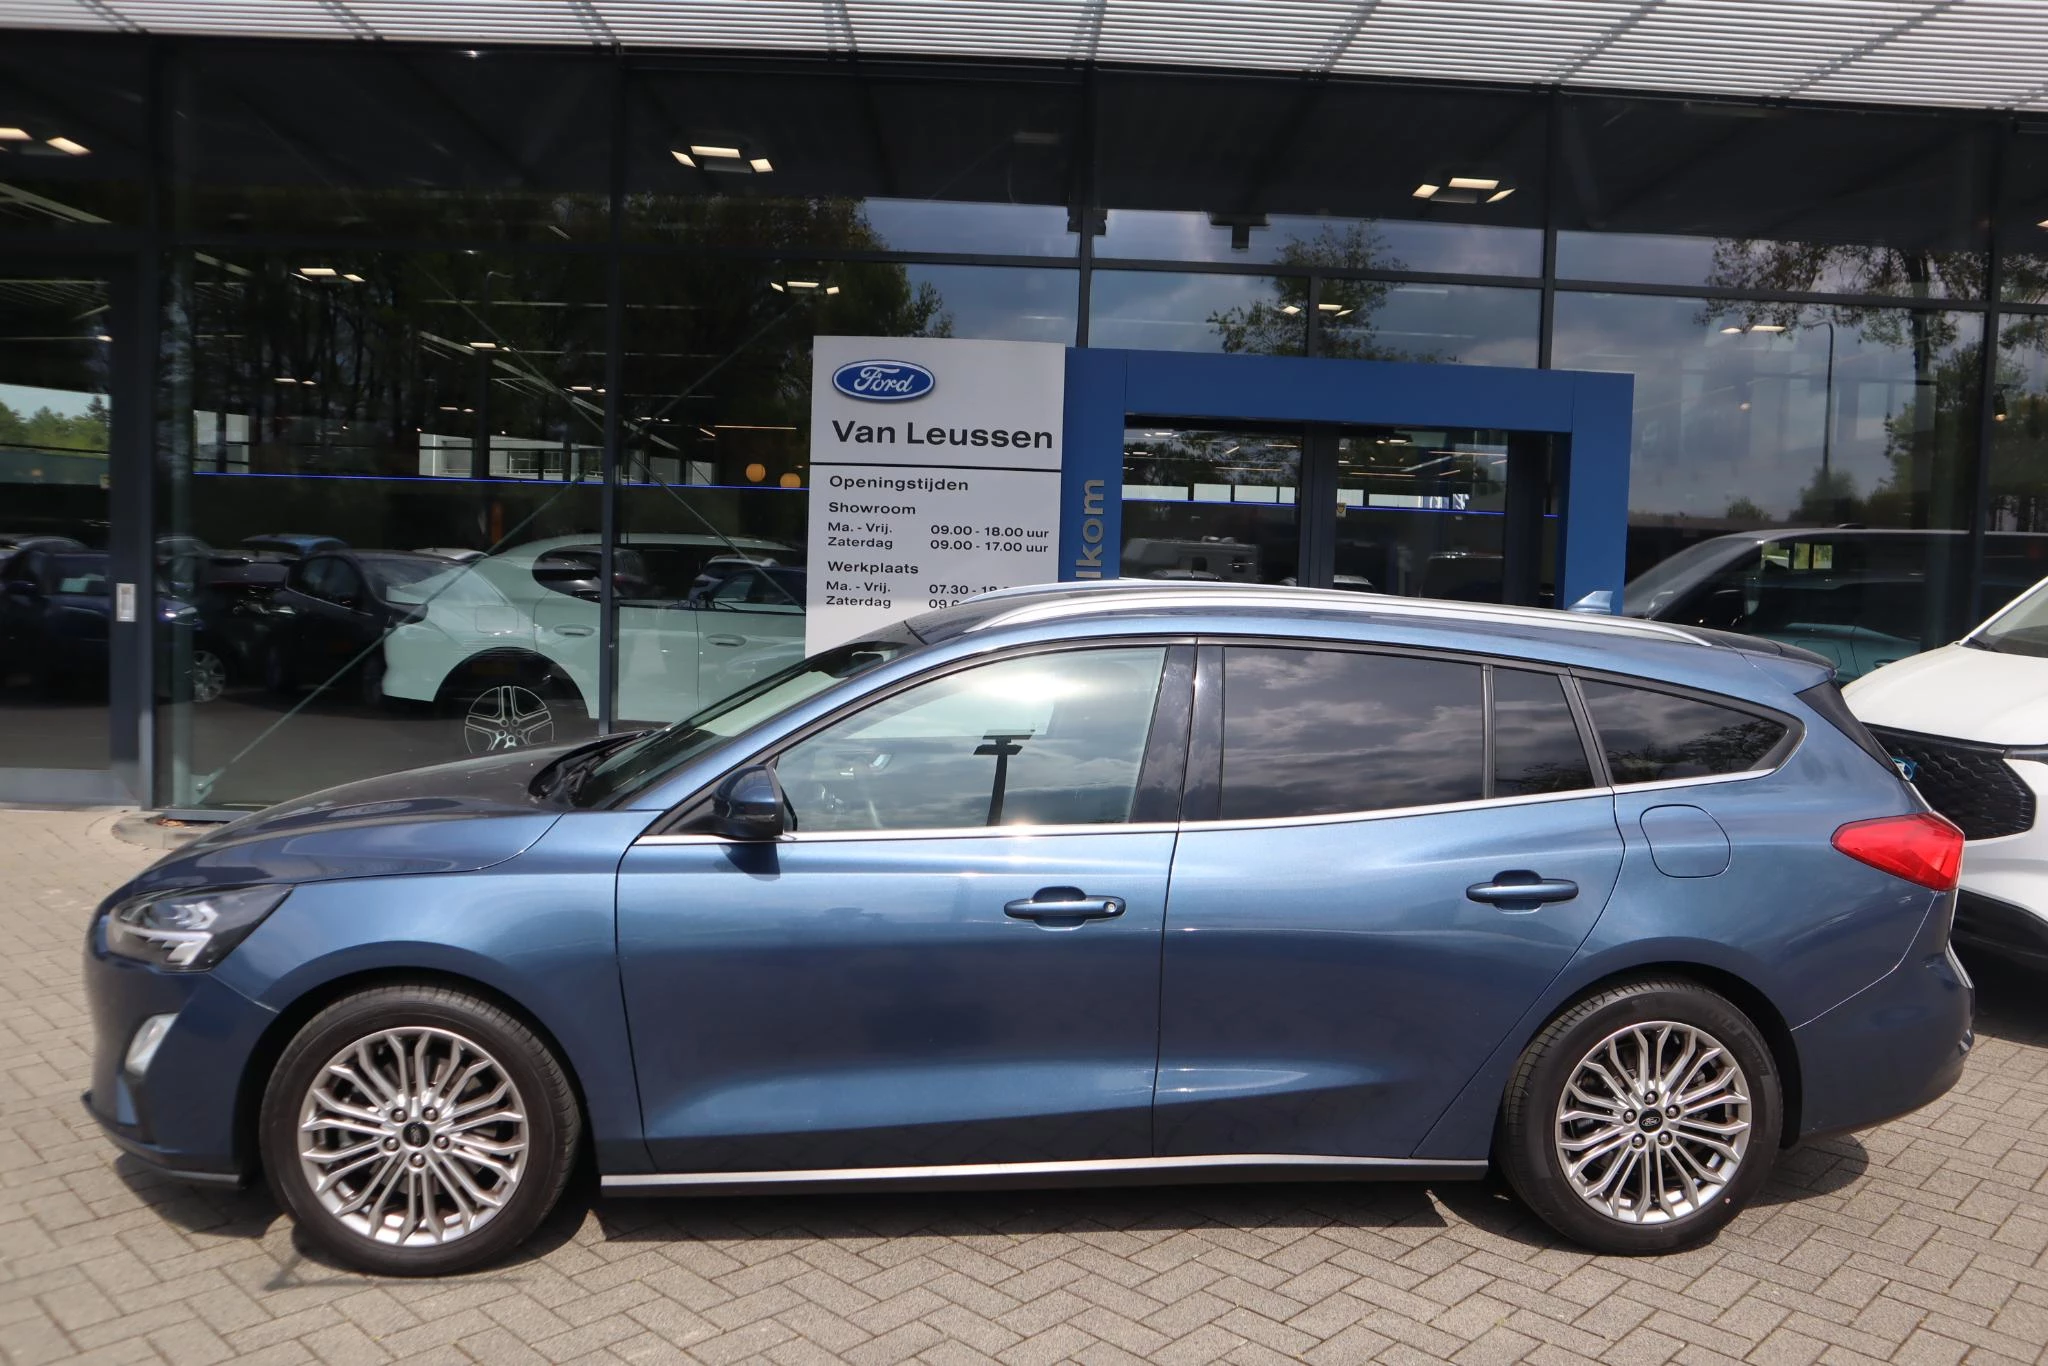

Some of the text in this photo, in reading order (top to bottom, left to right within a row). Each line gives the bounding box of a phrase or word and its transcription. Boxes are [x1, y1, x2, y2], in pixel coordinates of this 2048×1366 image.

[853, 366, 914, 393] Ford
[831, 420, 1053, 449] Van Leussen
[829, 475, 969, 491] Openingstijden
[828, 502, 916, 515] Showroom
[827, 522, 854, 532] Ma.
[865, 523, 893, 535] Vrij.
[930, 525, 973, 536] 09.00
[984, 527, 1024, 537] 18.00
[1026, 530, 1049, 538] uur
[1075, 480, 1105, 579] lkom
[827, 536, 893, 550] Zaterdag
[930, 540, 973, 550] 09.00
[984, 542, 1023, 552] 17.00
[1026, 545, 1049, 553] uur
[828, 561, 919, 574] Werkplaats
[826, 581, 852, 591] Ma.
[864, 583, 891, 593] Vrij.
[929, 584, 969, 595] 07.30
[826, 596, 960, 609] Zaterdag 09.0
